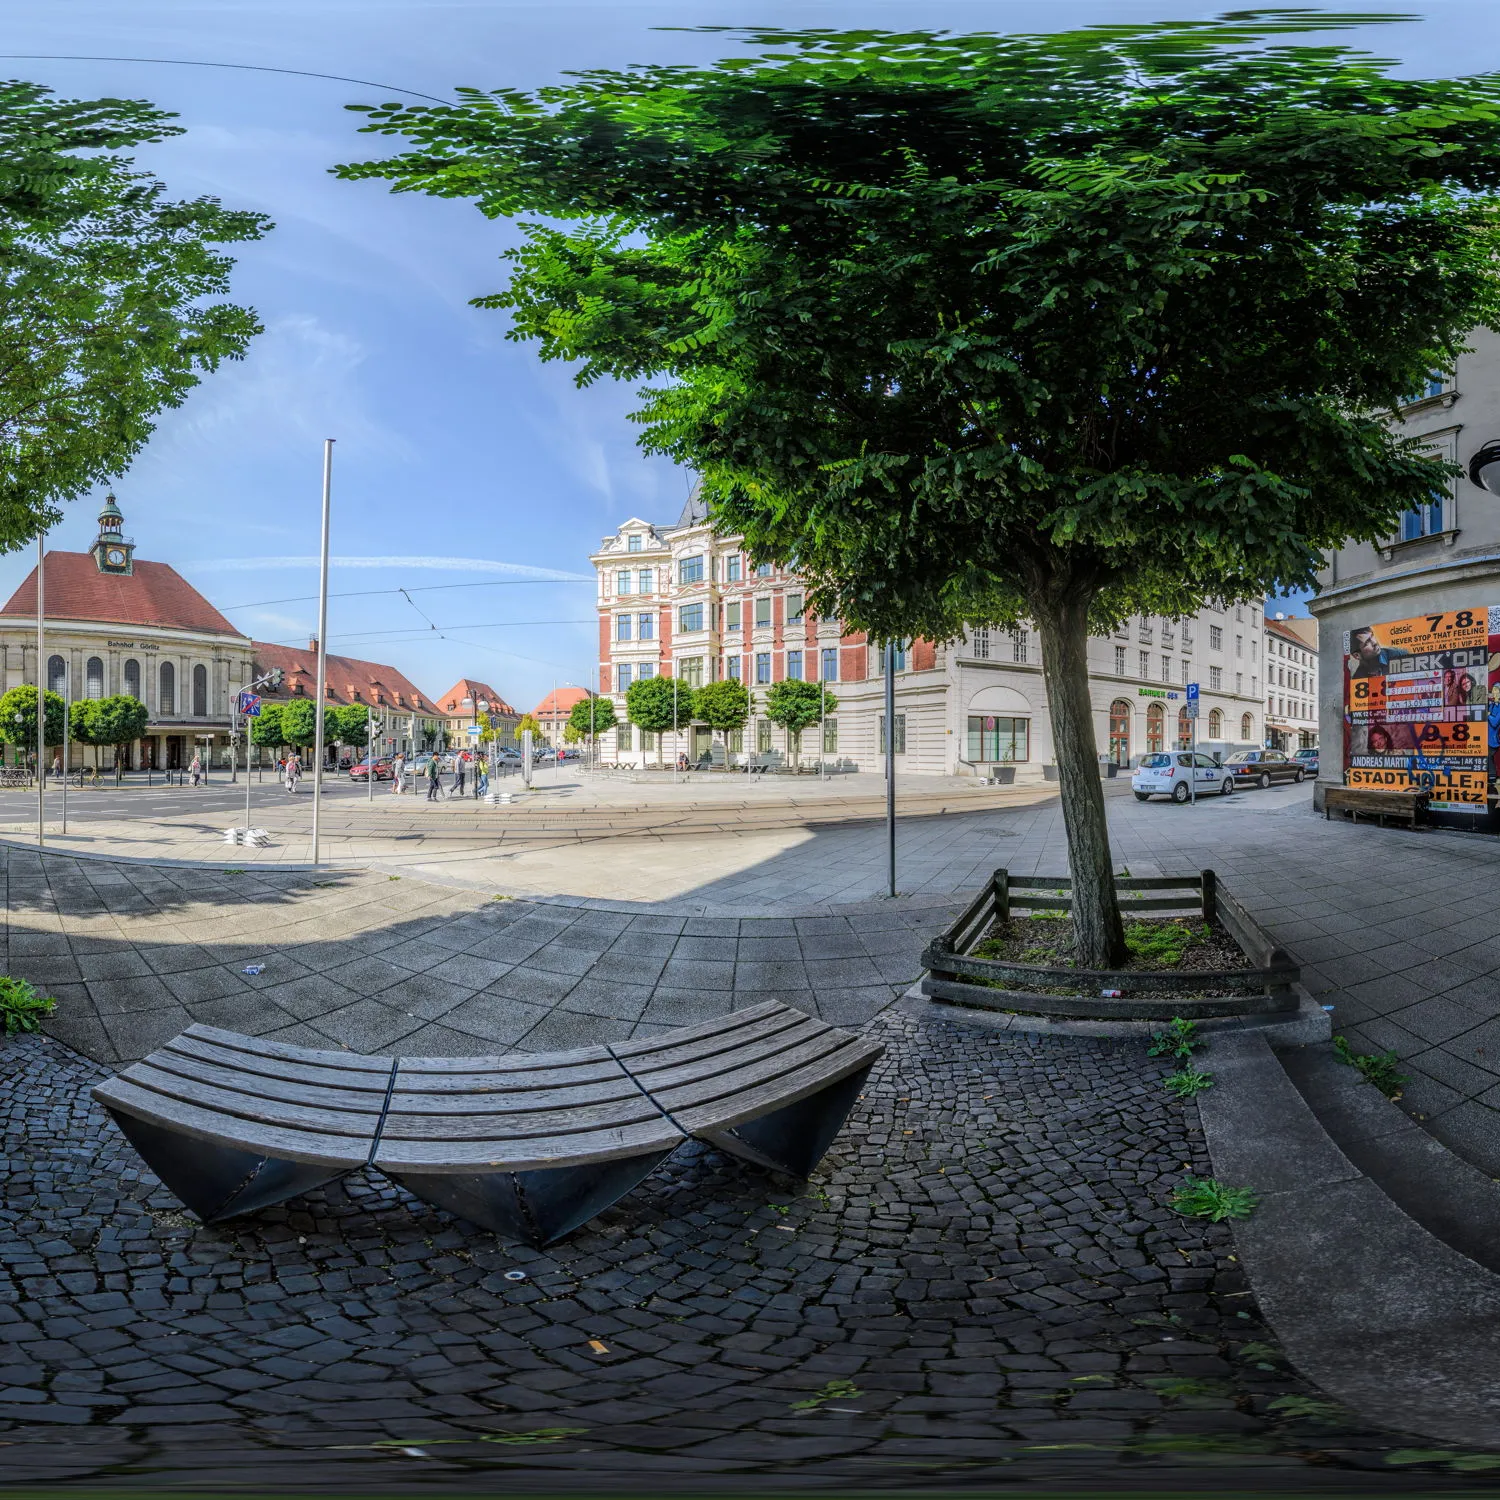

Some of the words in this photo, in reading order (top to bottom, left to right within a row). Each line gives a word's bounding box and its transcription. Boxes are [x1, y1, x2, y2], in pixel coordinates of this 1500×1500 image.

[1390, 624, 1413, 635] classic
[1426, 611, 1484, 632] 7.8.
[1391, 637, 1413, 645] NEVER
[1413, 634, 1431, 642] STOP
[1433, 631, 1451, 639] THAT
[1453, 627, 1485, 637] FEELING
[107, 641, 134, 649] Bahnhof
[1352, 757, 1383, 768] ANDREAS
[1384, 757, 1412, 769] MARTIN
